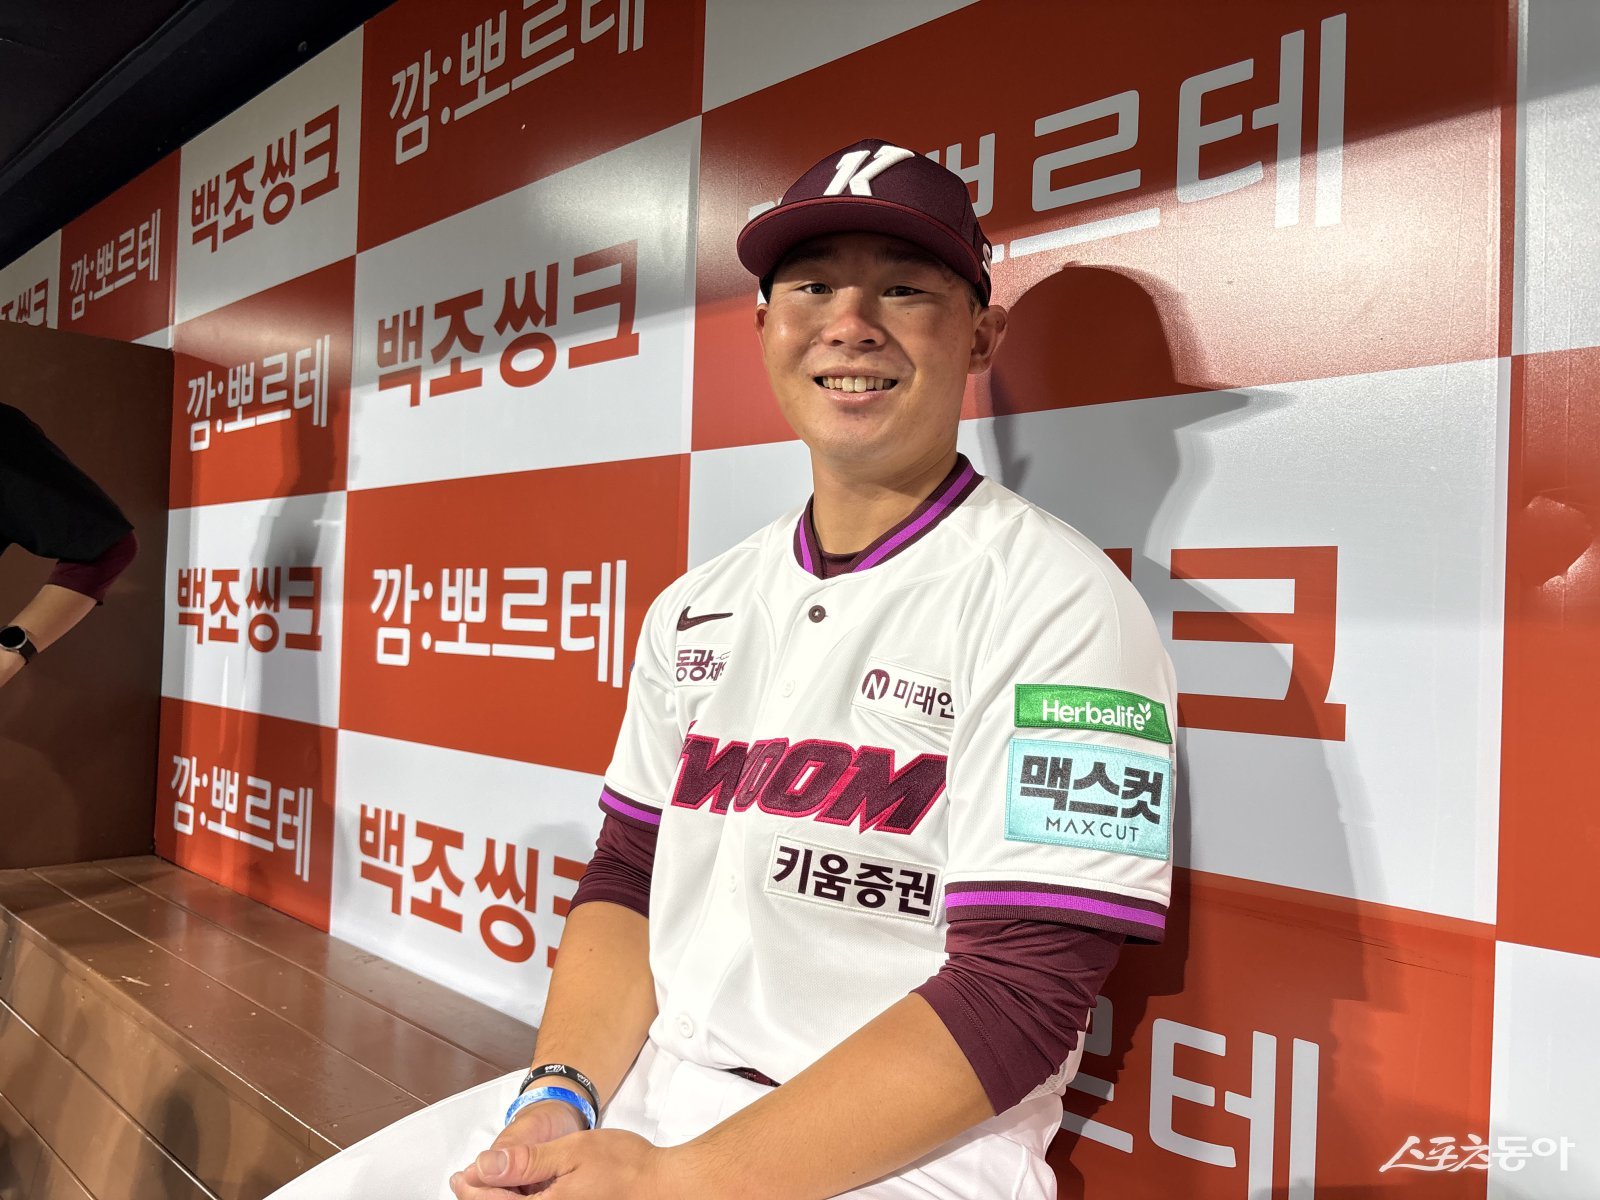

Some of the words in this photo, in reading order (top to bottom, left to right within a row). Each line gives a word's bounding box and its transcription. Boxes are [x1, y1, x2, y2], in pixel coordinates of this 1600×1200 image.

[191, 104, 340, 253] 백조씽크
[823, 145, 916, 197] K
[377, 239, 640, 407] 백조씽크
[177, 565, 323, 653] 백조씽크
[1042, 699, 1146, 731] Herbalife
[671, 720, 948, 835] WOOM
[1020, 754, 1164, 825] 맥스컷
[1046, 816, 1139, 842] MAXCUT
[772, 845, 936, 917] 키움증권
